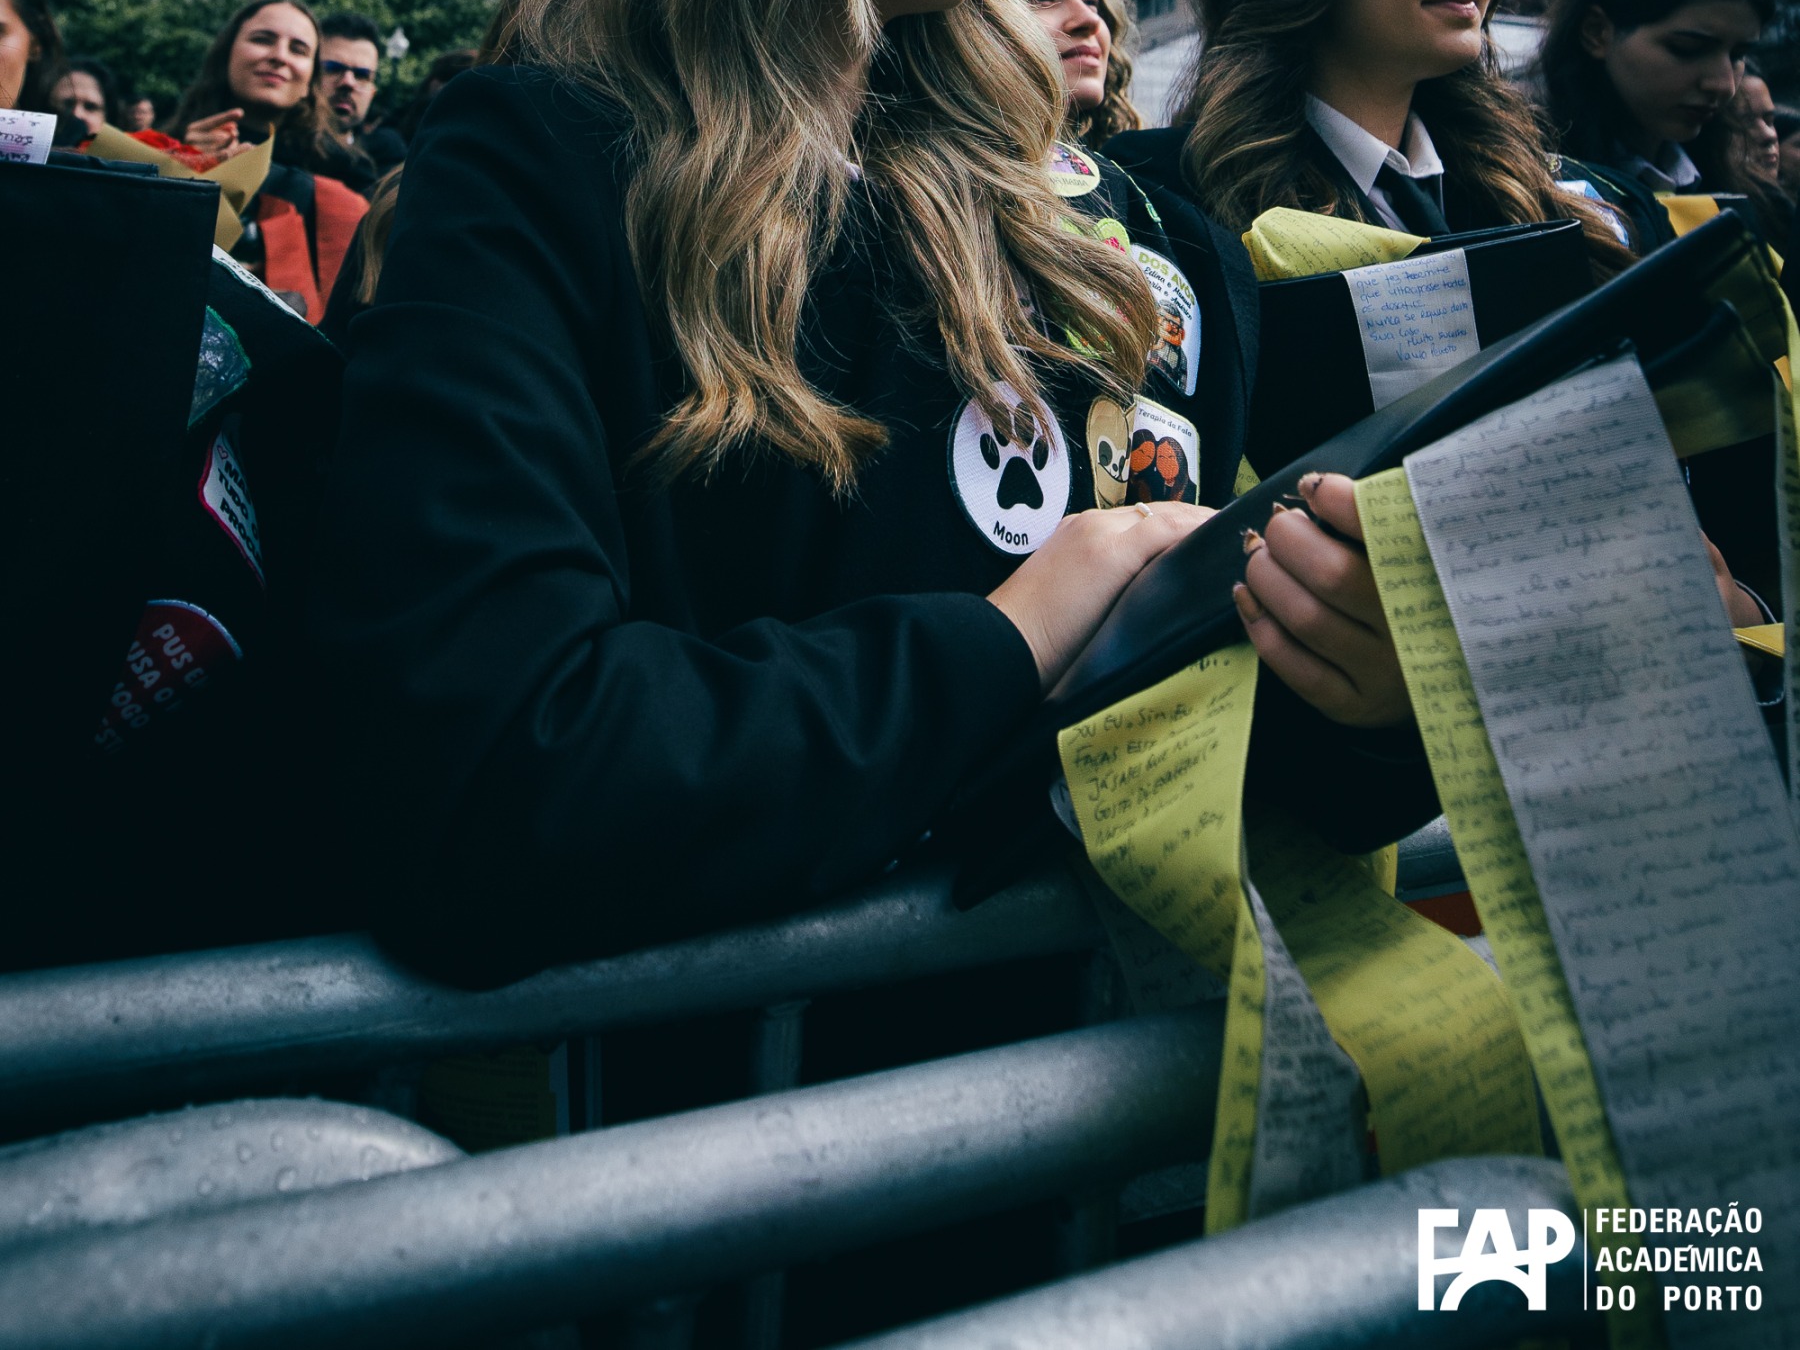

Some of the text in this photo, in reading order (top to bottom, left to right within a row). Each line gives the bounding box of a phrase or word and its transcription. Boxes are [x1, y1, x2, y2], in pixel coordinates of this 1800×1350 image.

[1138, 251, 1169, 275] DOS
[1356, 277, 1379, 293] que
[1360, 289, 1381, 304] que
[1365, 314, 1401, 330] Nunca
[1404, 312, 1416, 322] se
[1138, 408, 1167, 425] Terapia
[1167, 420, 1177, 429] da
[217, 467, 250, 520] TUDO
[993, 520, 1029, 546] Moon
[151, 622, 195, 671] PUS
